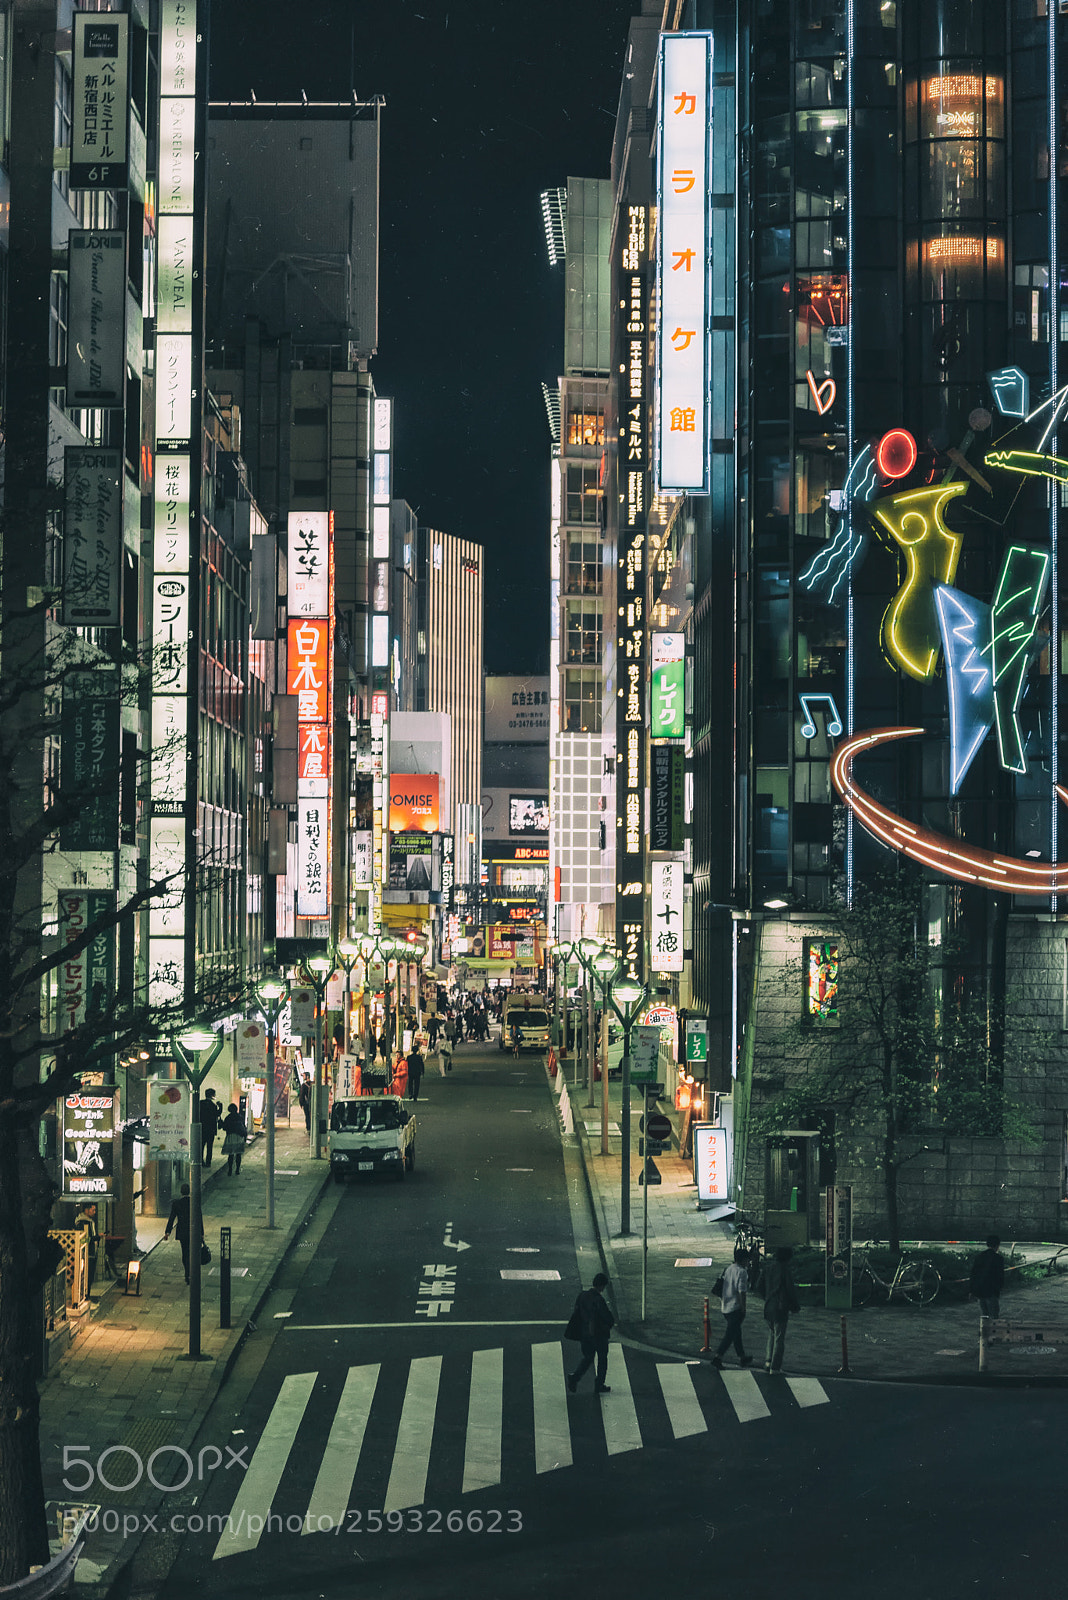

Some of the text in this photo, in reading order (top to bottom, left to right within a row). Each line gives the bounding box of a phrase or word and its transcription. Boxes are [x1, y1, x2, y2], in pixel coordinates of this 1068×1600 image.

[174, 3, 186, 89] わたしの英会話
[83, 74, 99, 146] 新宿西口店
[88, 167, 109, 181] 6F
[628, 206, 639, 271] MITSUBA
[172, 237, 187, 312] VAN-VEAL
[669, 91, 697, 433] カラオケ館
[191, 389, 197, 398] 5
[165, 465, 180, 562] 桜花クリニック
[618, 494, 625, 503] 7
[618, 558, 625, 568] 7
[188, 630, 194, 639] 3
[292, 621, 324, 721] 白木屋
[627, 664, 640, 714] ホットヨガ
[617, 688, 624, 698] 4
[659, 675, 677, 725] レイク
[625, 713, 641, 721] LAVA
[187, 752, 193, 760] 2
[301, 726, 327, 778] 木屋
[617, 753, 623, 763] 3
[655, 747, 669, 847] 西新宿メンタルクリニック
[617, 817, 623, 827] 2
[656, 904, 679, 953] 十徳
[692, 1034, 701, 1058] レイク
[65, 1093, 113, 1109] Jazz
[74, 1109, 104, 1119] Drink
[707, 1135, 719, 1194] カラオケ館
